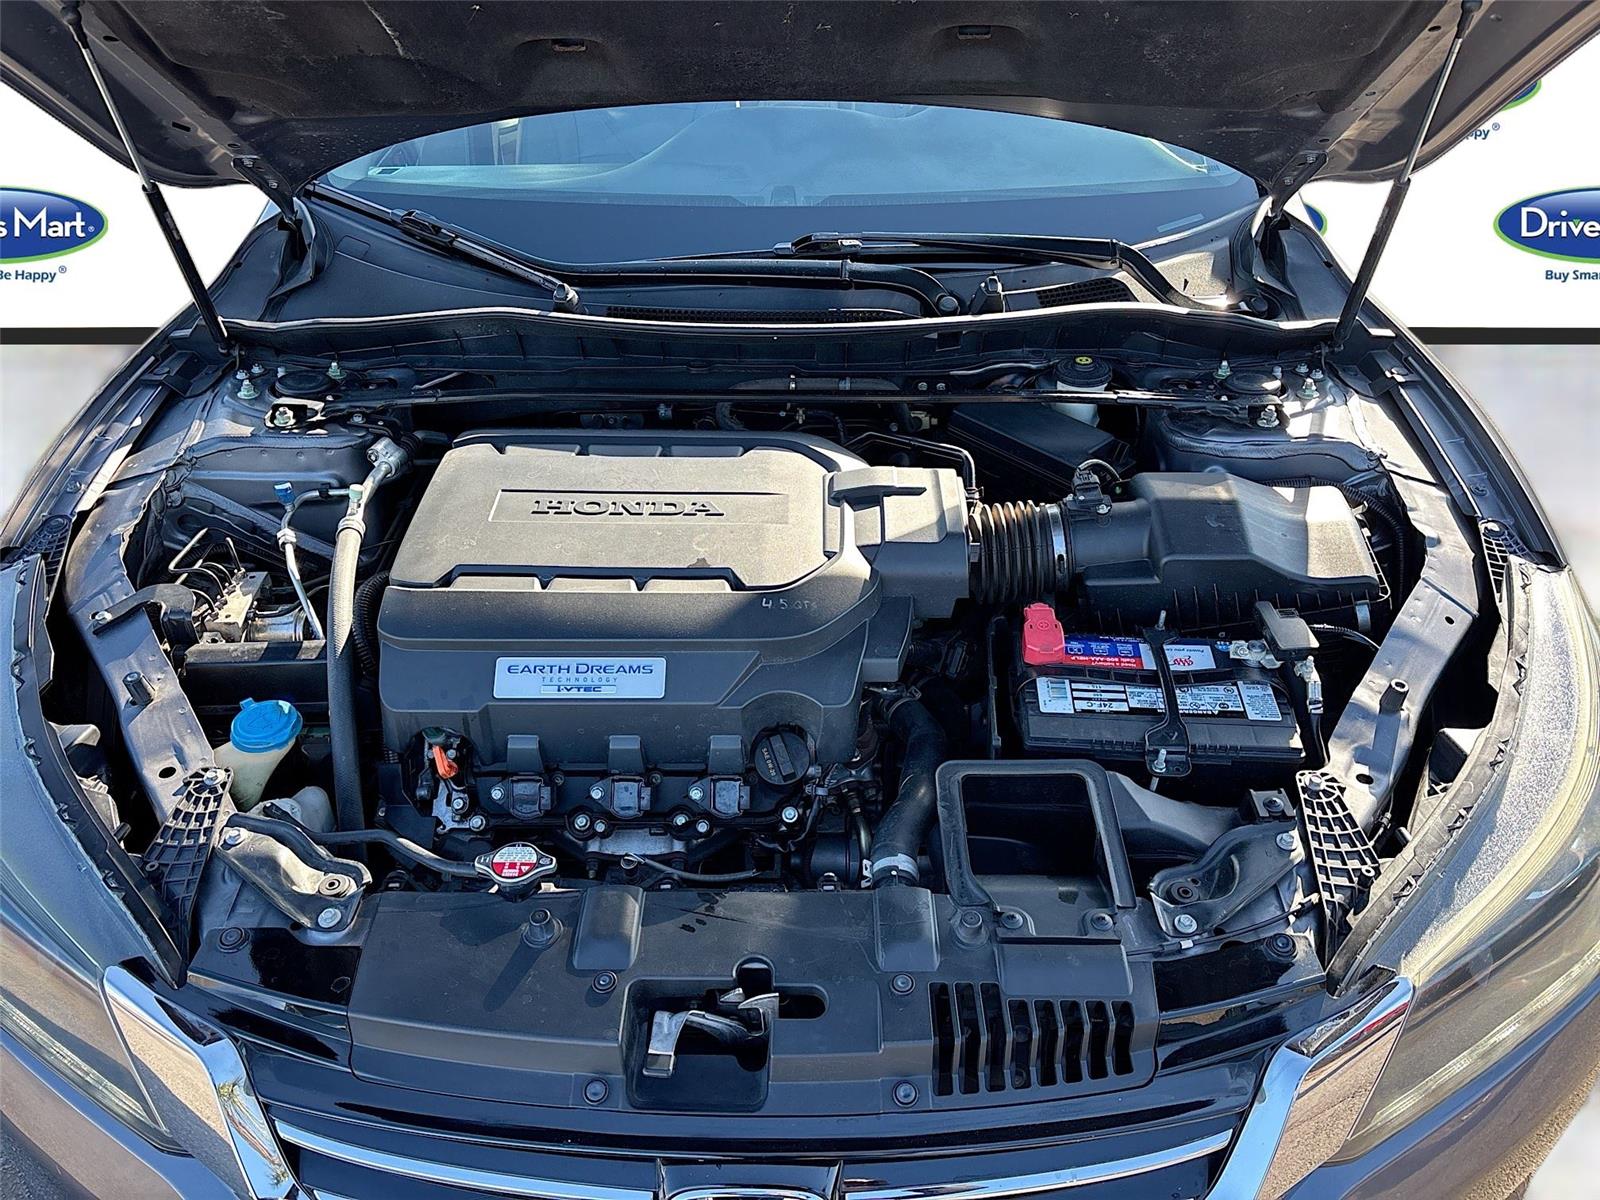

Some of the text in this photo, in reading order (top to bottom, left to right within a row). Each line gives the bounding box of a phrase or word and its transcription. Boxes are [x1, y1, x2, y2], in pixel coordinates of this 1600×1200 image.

[14, 206, 86, 237] Mart
[1520, 206, 1600, 238] Drive
[15, 269, 57, 283] Happy
[1545, 269, 1600, 283] Buy Sma
[530, 499, 725, 517] HONDA
[507, 663, 654, 674] EARTH DREAMS
